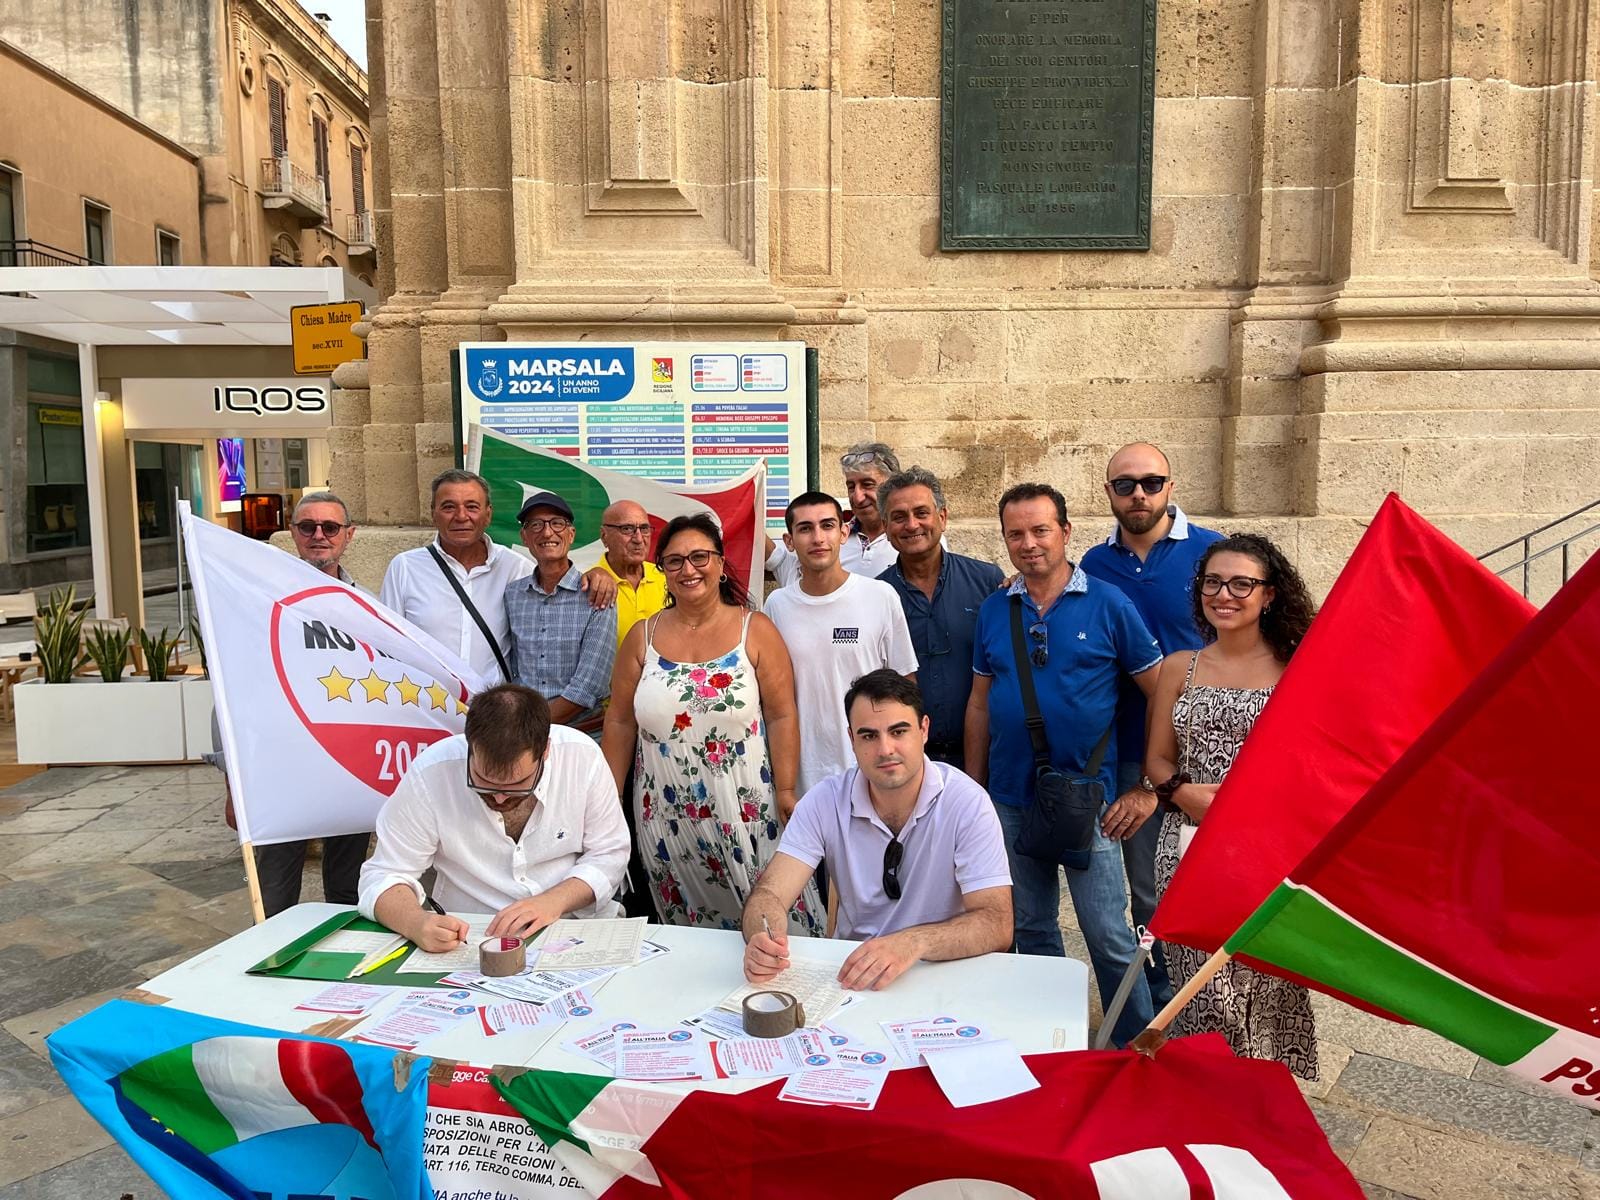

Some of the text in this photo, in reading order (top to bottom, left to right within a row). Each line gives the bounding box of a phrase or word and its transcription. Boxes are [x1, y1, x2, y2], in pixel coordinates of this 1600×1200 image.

[1042, 13, 1069, 24] PER
[975, 34, 1122, 46] ONORARE LA MEMORIA
[990, 55, 1108, 66] DEI SUOI GENITORI
[967, 77, 1026, 88] GIUSEPPE
[993, 98, 1104, 109] FECE EDIFICARE
[997, 119, 1098, 131] LA FACCIATA
[981, 140, 1114, 153] DI QUESTO TEMPIO
[1003, 162, 1093, 173] MONSIGNORE
[976, 183, 1117, 195] PASQUALE LOMBARDO
[300, 312, 352, 326] Chiesa Madre
[508, 358, 626, 377] MARSALA
[508, 380, 555, 394] 2024
[214, 386, 326, 416] IQOS
[834, 628, 858, 638] VANS
[1539, 1057, 1600, 1102] PS
[436, 1114, 461, 1126] CHE
[466, 1116, 485, 1129] SIA
[489, 1120, 537, 1137] ABROG
[496, 1137, 521, 1151] PER
[458, 1145, 498, 1160] DELLE
[503, 1153, 556, 1170] REGIONI
[448, 1160, 471, 1173] 116,
[475, 1160, 510, 1176] TERZO
[511, 1169, 556, 1187] COMMA,
[559, 1176, 585, 1189] DEL
[451, 1189, 492, 1200] anche
[495, 1190, 506, 1200] tu
